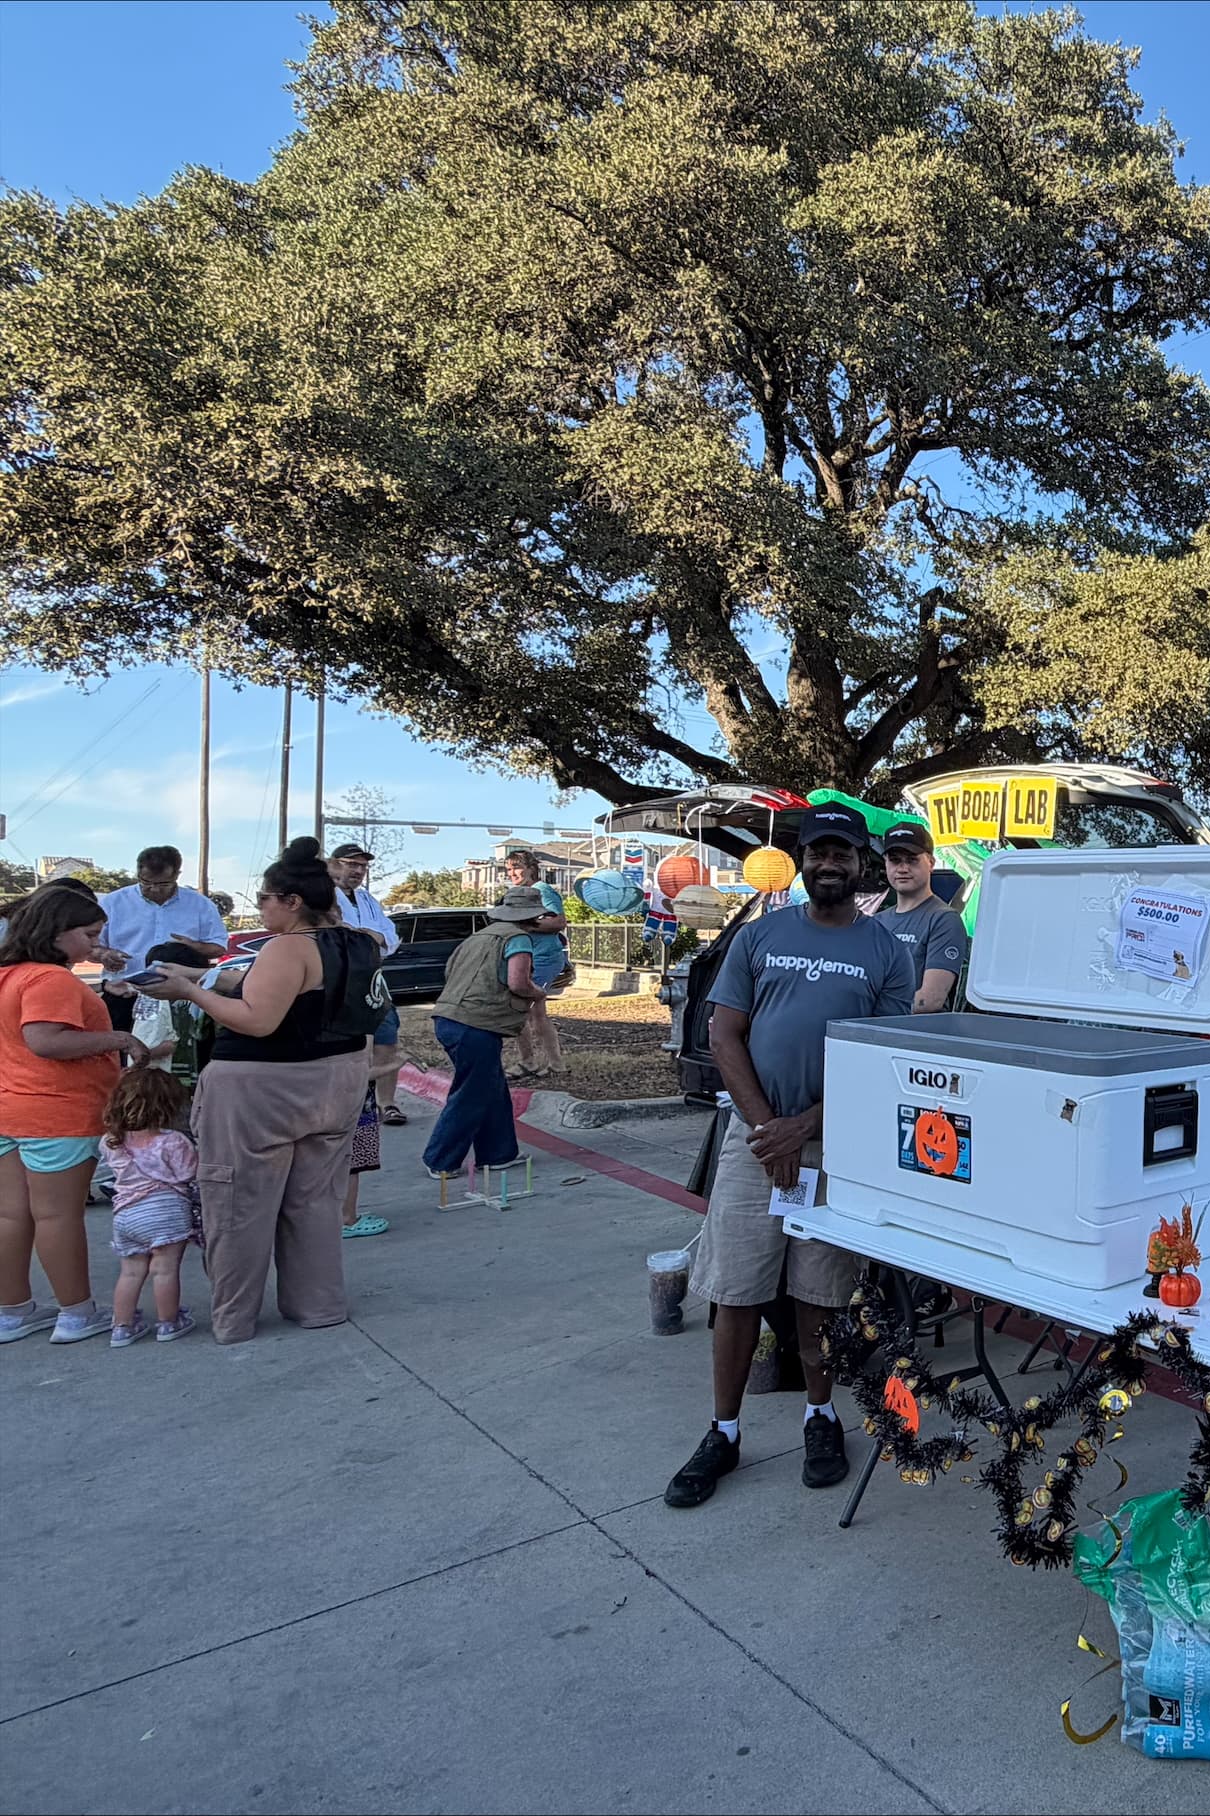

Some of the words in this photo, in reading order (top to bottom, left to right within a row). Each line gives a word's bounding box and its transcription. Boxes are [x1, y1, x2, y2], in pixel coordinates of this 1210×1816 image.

[933, 796, 959, 835] TH
[961, 790, 999, 822] BOBA
[1014, 789, 1048, 825] LAB
[1130, 896, 1204, 918] CONGRATULATIONS
[1137, 906, 1180, 923] $500.00
[908, 1067, 948, 1089] IGLO
[901, 1123, 915, 1150] 7
[1194, 1719, 1206, 1743] FOR
[1154, 1734, 1166, 1754] 40
